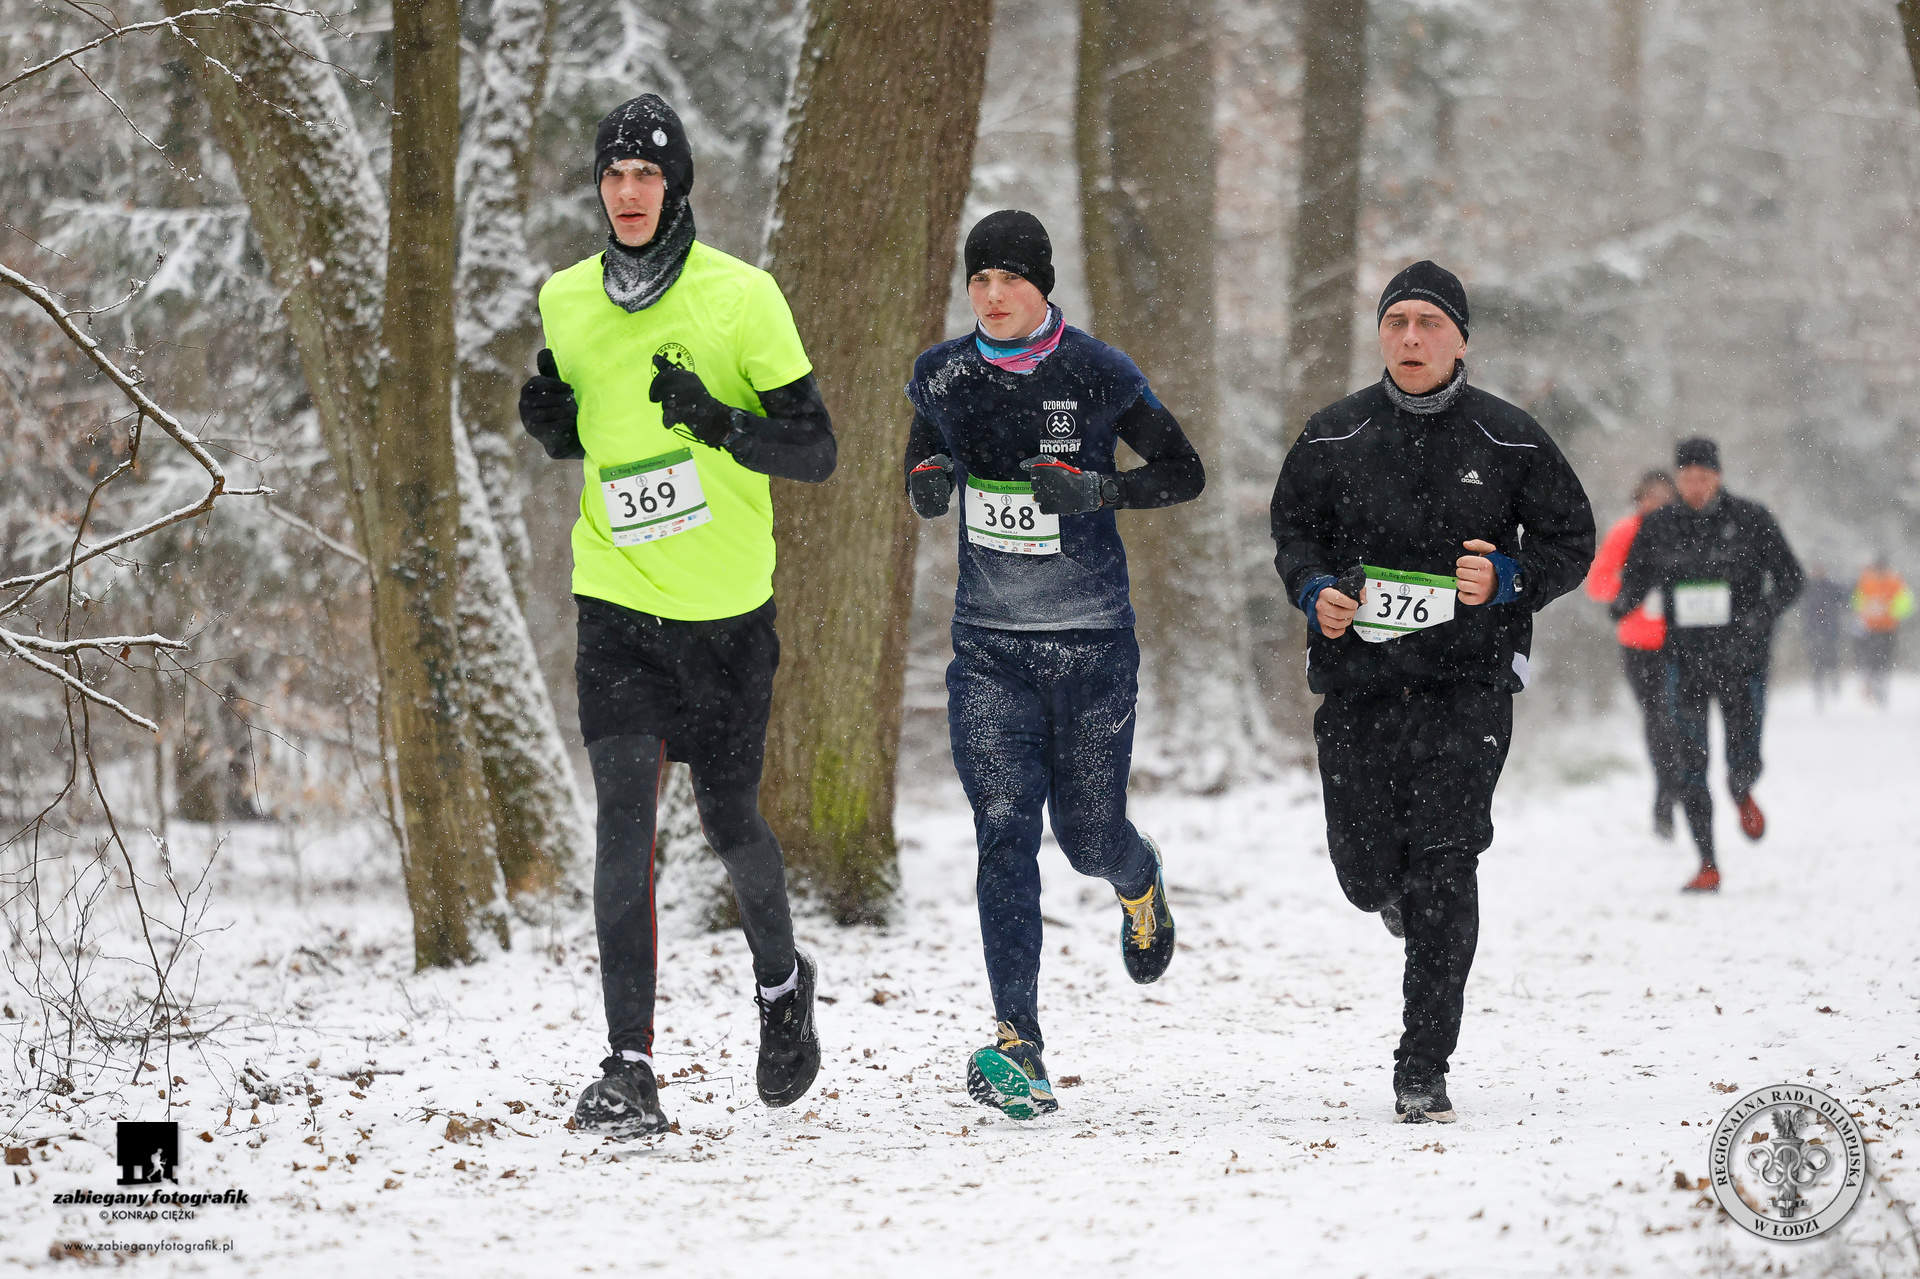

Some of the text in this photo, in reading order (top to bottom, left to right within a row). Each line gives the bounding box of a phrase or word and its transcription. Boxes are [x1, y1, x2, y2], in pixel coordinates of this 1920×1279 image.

[1042, 399, 1078, 410] OZORKÓW
[1040, 442, 1082, 453] monar
[618, 481, 675, 518] 369
[983, 503, 1035, 530] 368
[1376, 592, 1429, 623] 376
